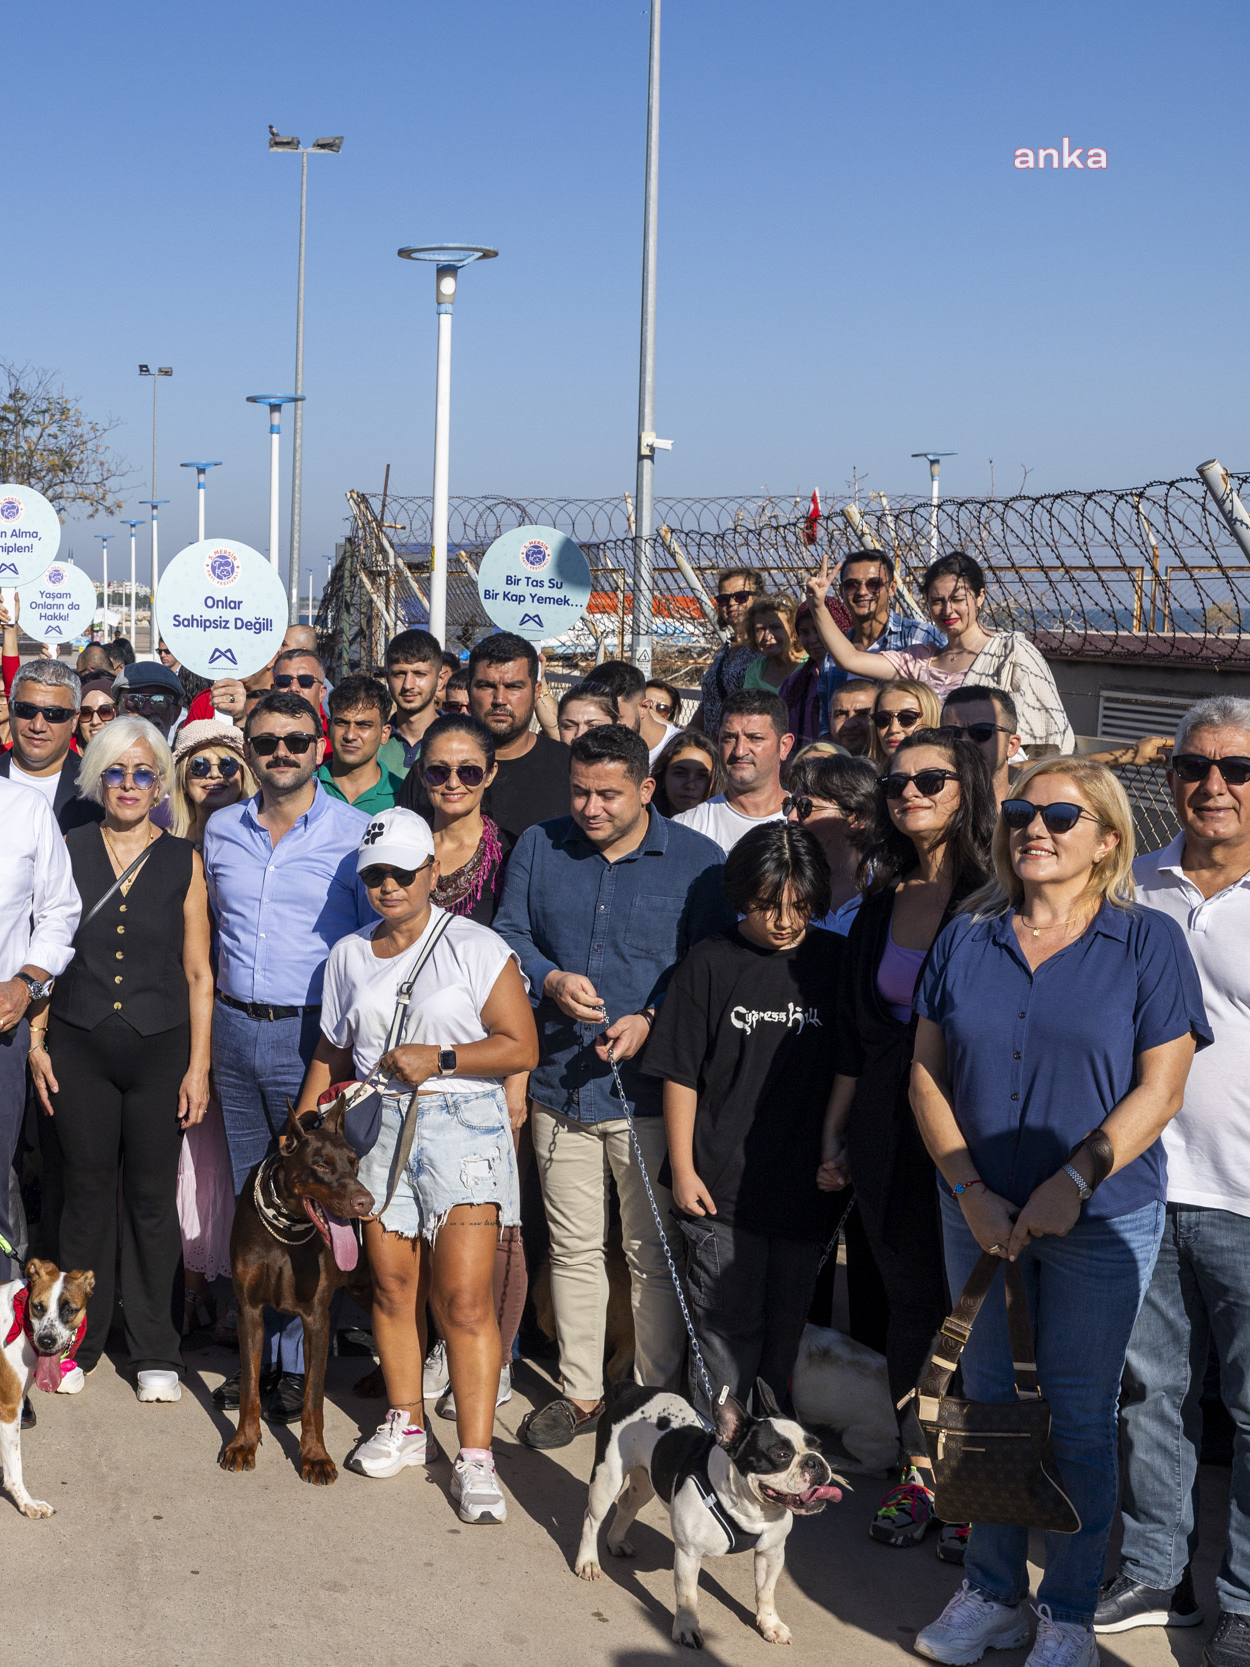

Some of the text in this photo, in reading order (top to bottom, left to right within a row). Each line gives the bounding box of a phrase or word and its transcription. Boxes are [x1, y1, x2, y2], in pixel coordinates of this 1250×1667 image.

[10, 529, 41, 541] Alma,
[214, 549, 237, 561] MERSİN
[506, 575, 563, 589] Bir Tas Su
[39, 591, 71, 601] Yaşam
[484, 589, 582, 607] Bir Kap Yemek...
[30, 601, 80, 610] Onların da
[204, 596, 243, 610] Onlar
[40, 613, 69, 621] Hakkı!
[173, 614, 273, 634] Sahipsiz Değil!
